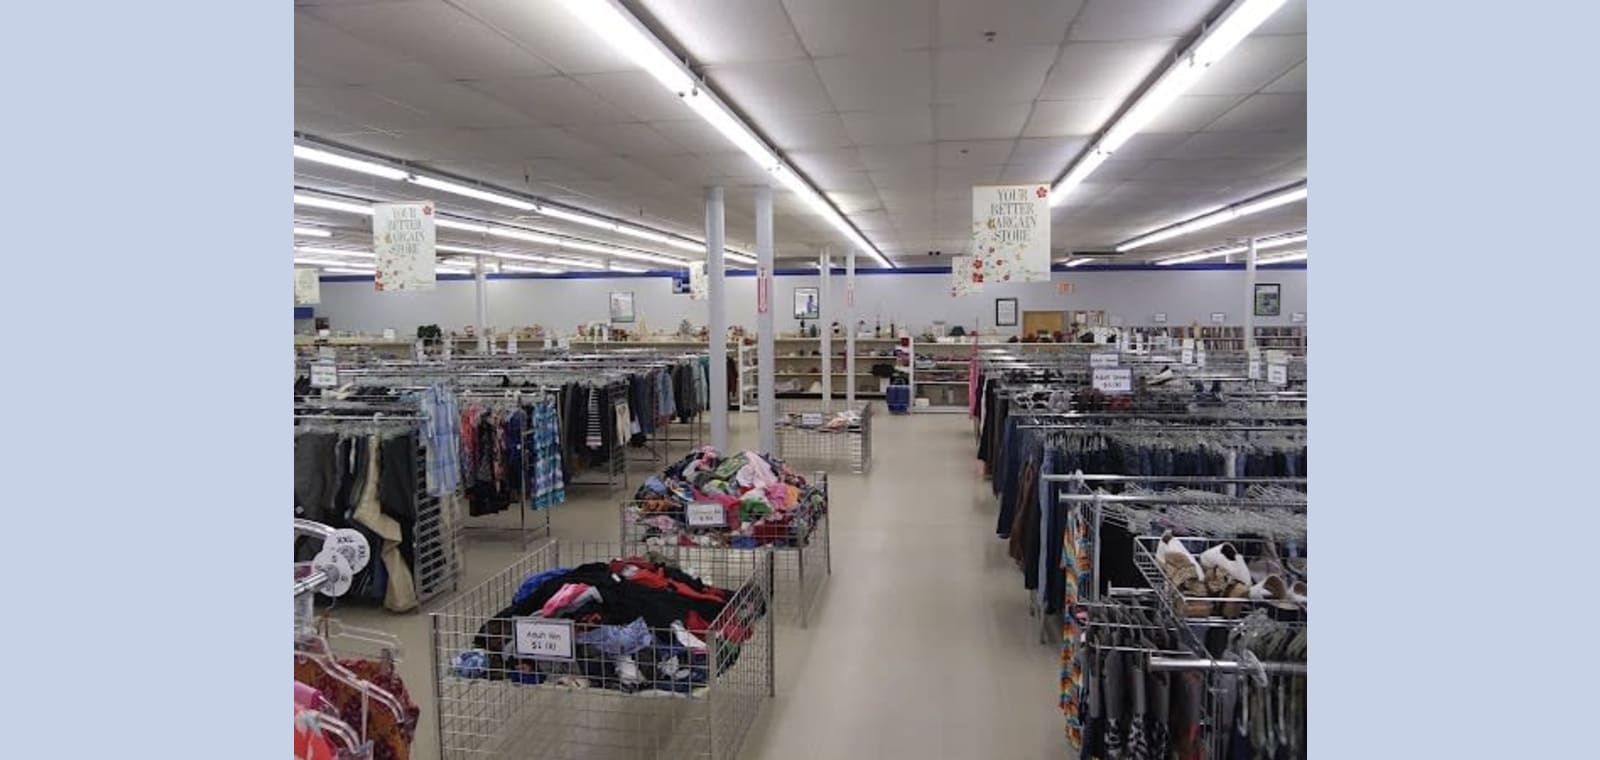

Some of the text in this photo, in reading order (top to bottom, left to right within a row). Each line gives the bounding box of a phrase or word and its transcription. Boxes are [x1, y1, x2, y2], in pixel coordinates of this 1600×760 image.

[997, 188, 1028, 201] YOUR
[990, 202, 1035, 215] BETTER
[994, 229, 1031, 242] STORE
[336, 535, 354, 543] XXL
